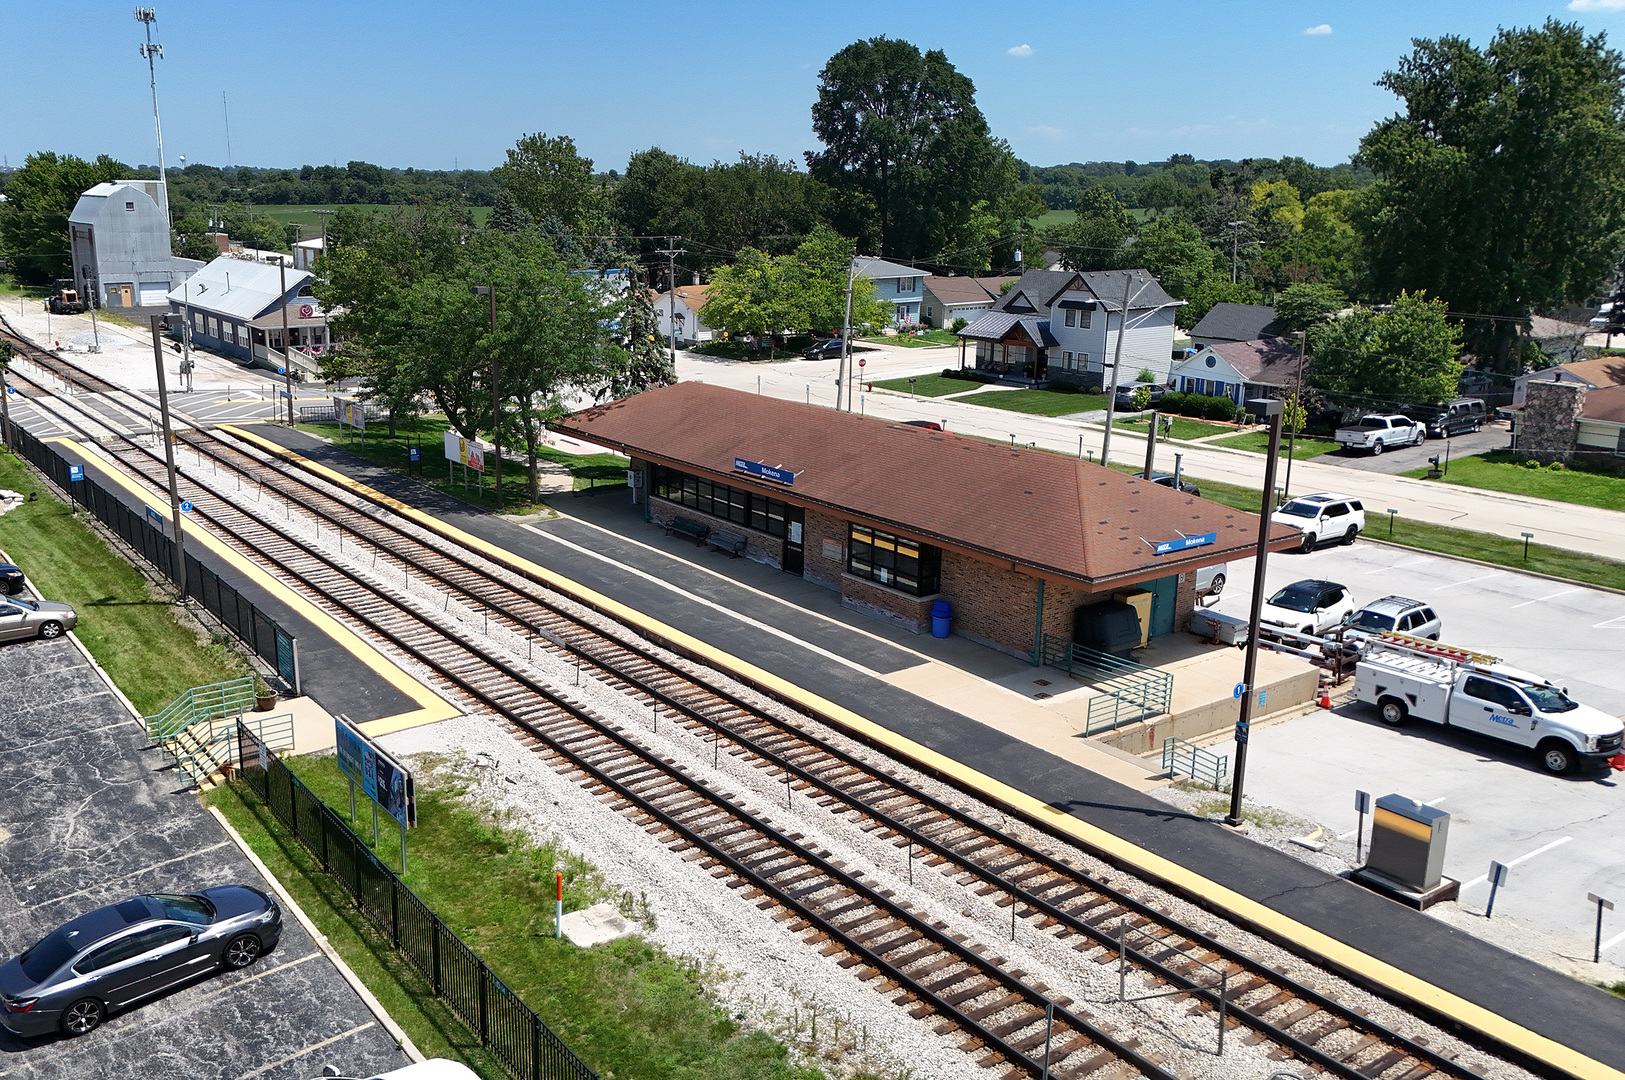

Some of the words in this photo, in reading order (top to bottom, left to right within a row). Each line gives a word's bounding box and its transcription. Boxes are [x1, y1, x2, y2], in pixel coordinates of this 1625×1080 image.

[761, 467, 781, 478] Mokena
[1185, 537, 1206, 546] Mokena
[1489, 713, 1515, 725] Metra
